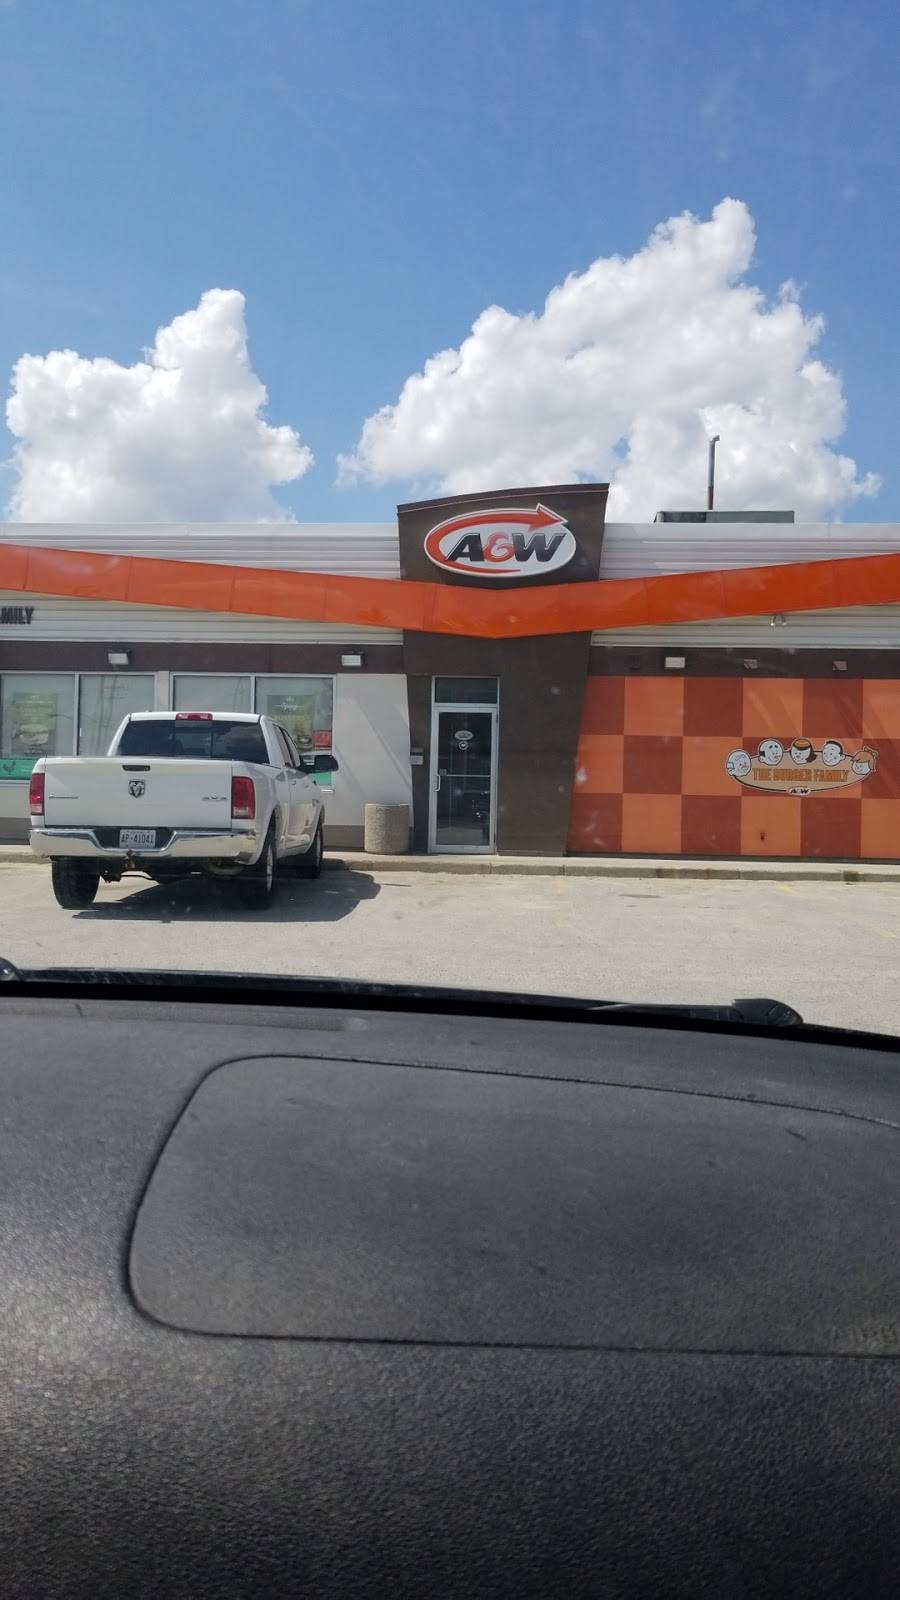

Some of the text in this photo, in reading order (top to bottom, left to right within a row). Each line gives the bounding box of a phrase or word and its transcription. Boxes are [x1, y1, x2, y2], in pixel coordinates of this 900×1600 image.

[445, 532, 566, 562] A&W
[0, 607, 34, 624] MILY
[752, 768, 848, 783] THE BURGER FAMILY
